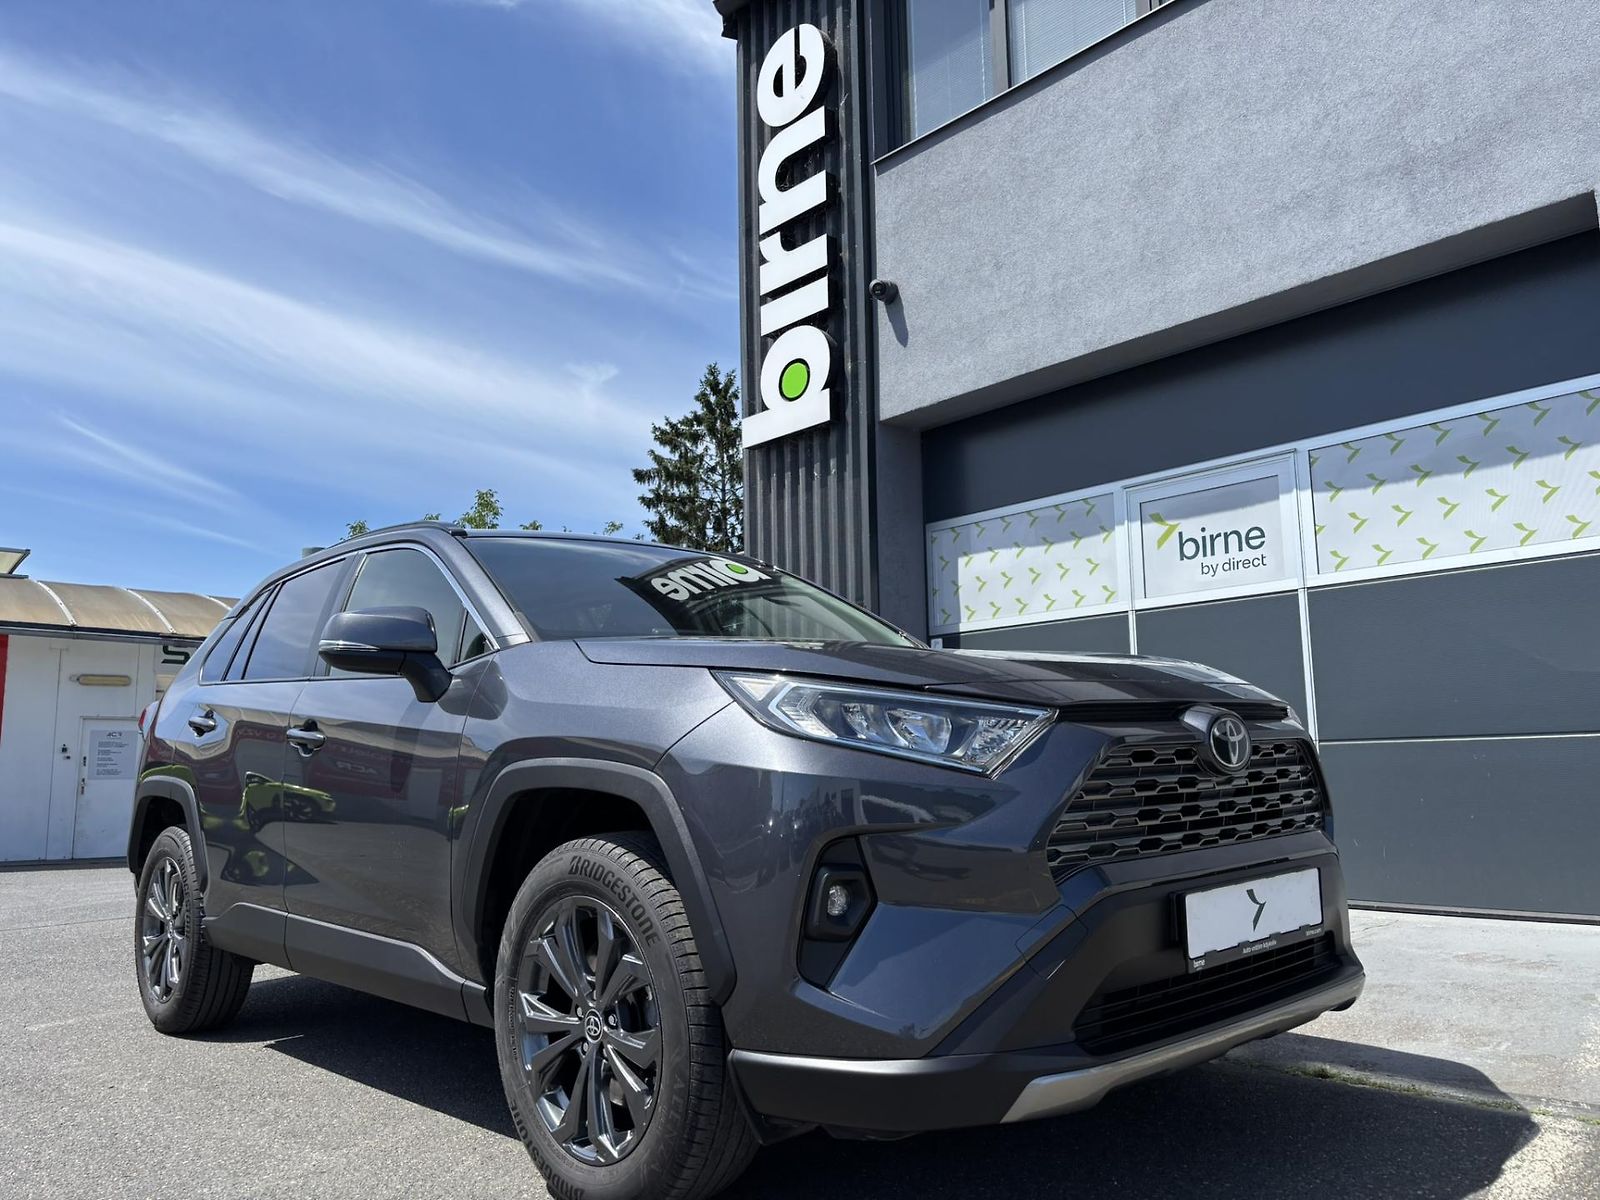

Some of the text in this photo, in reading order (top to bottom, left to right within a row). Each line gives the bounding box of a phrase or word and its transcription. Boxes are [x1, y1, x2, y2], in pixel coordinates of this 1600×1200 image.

[742, 23, 831, 448] birne
[1178, 526, 1266, 561] birne
[1200, 554, 1267, 577] by direct
[568, 856, 660, 947] BRIDGESTONE
